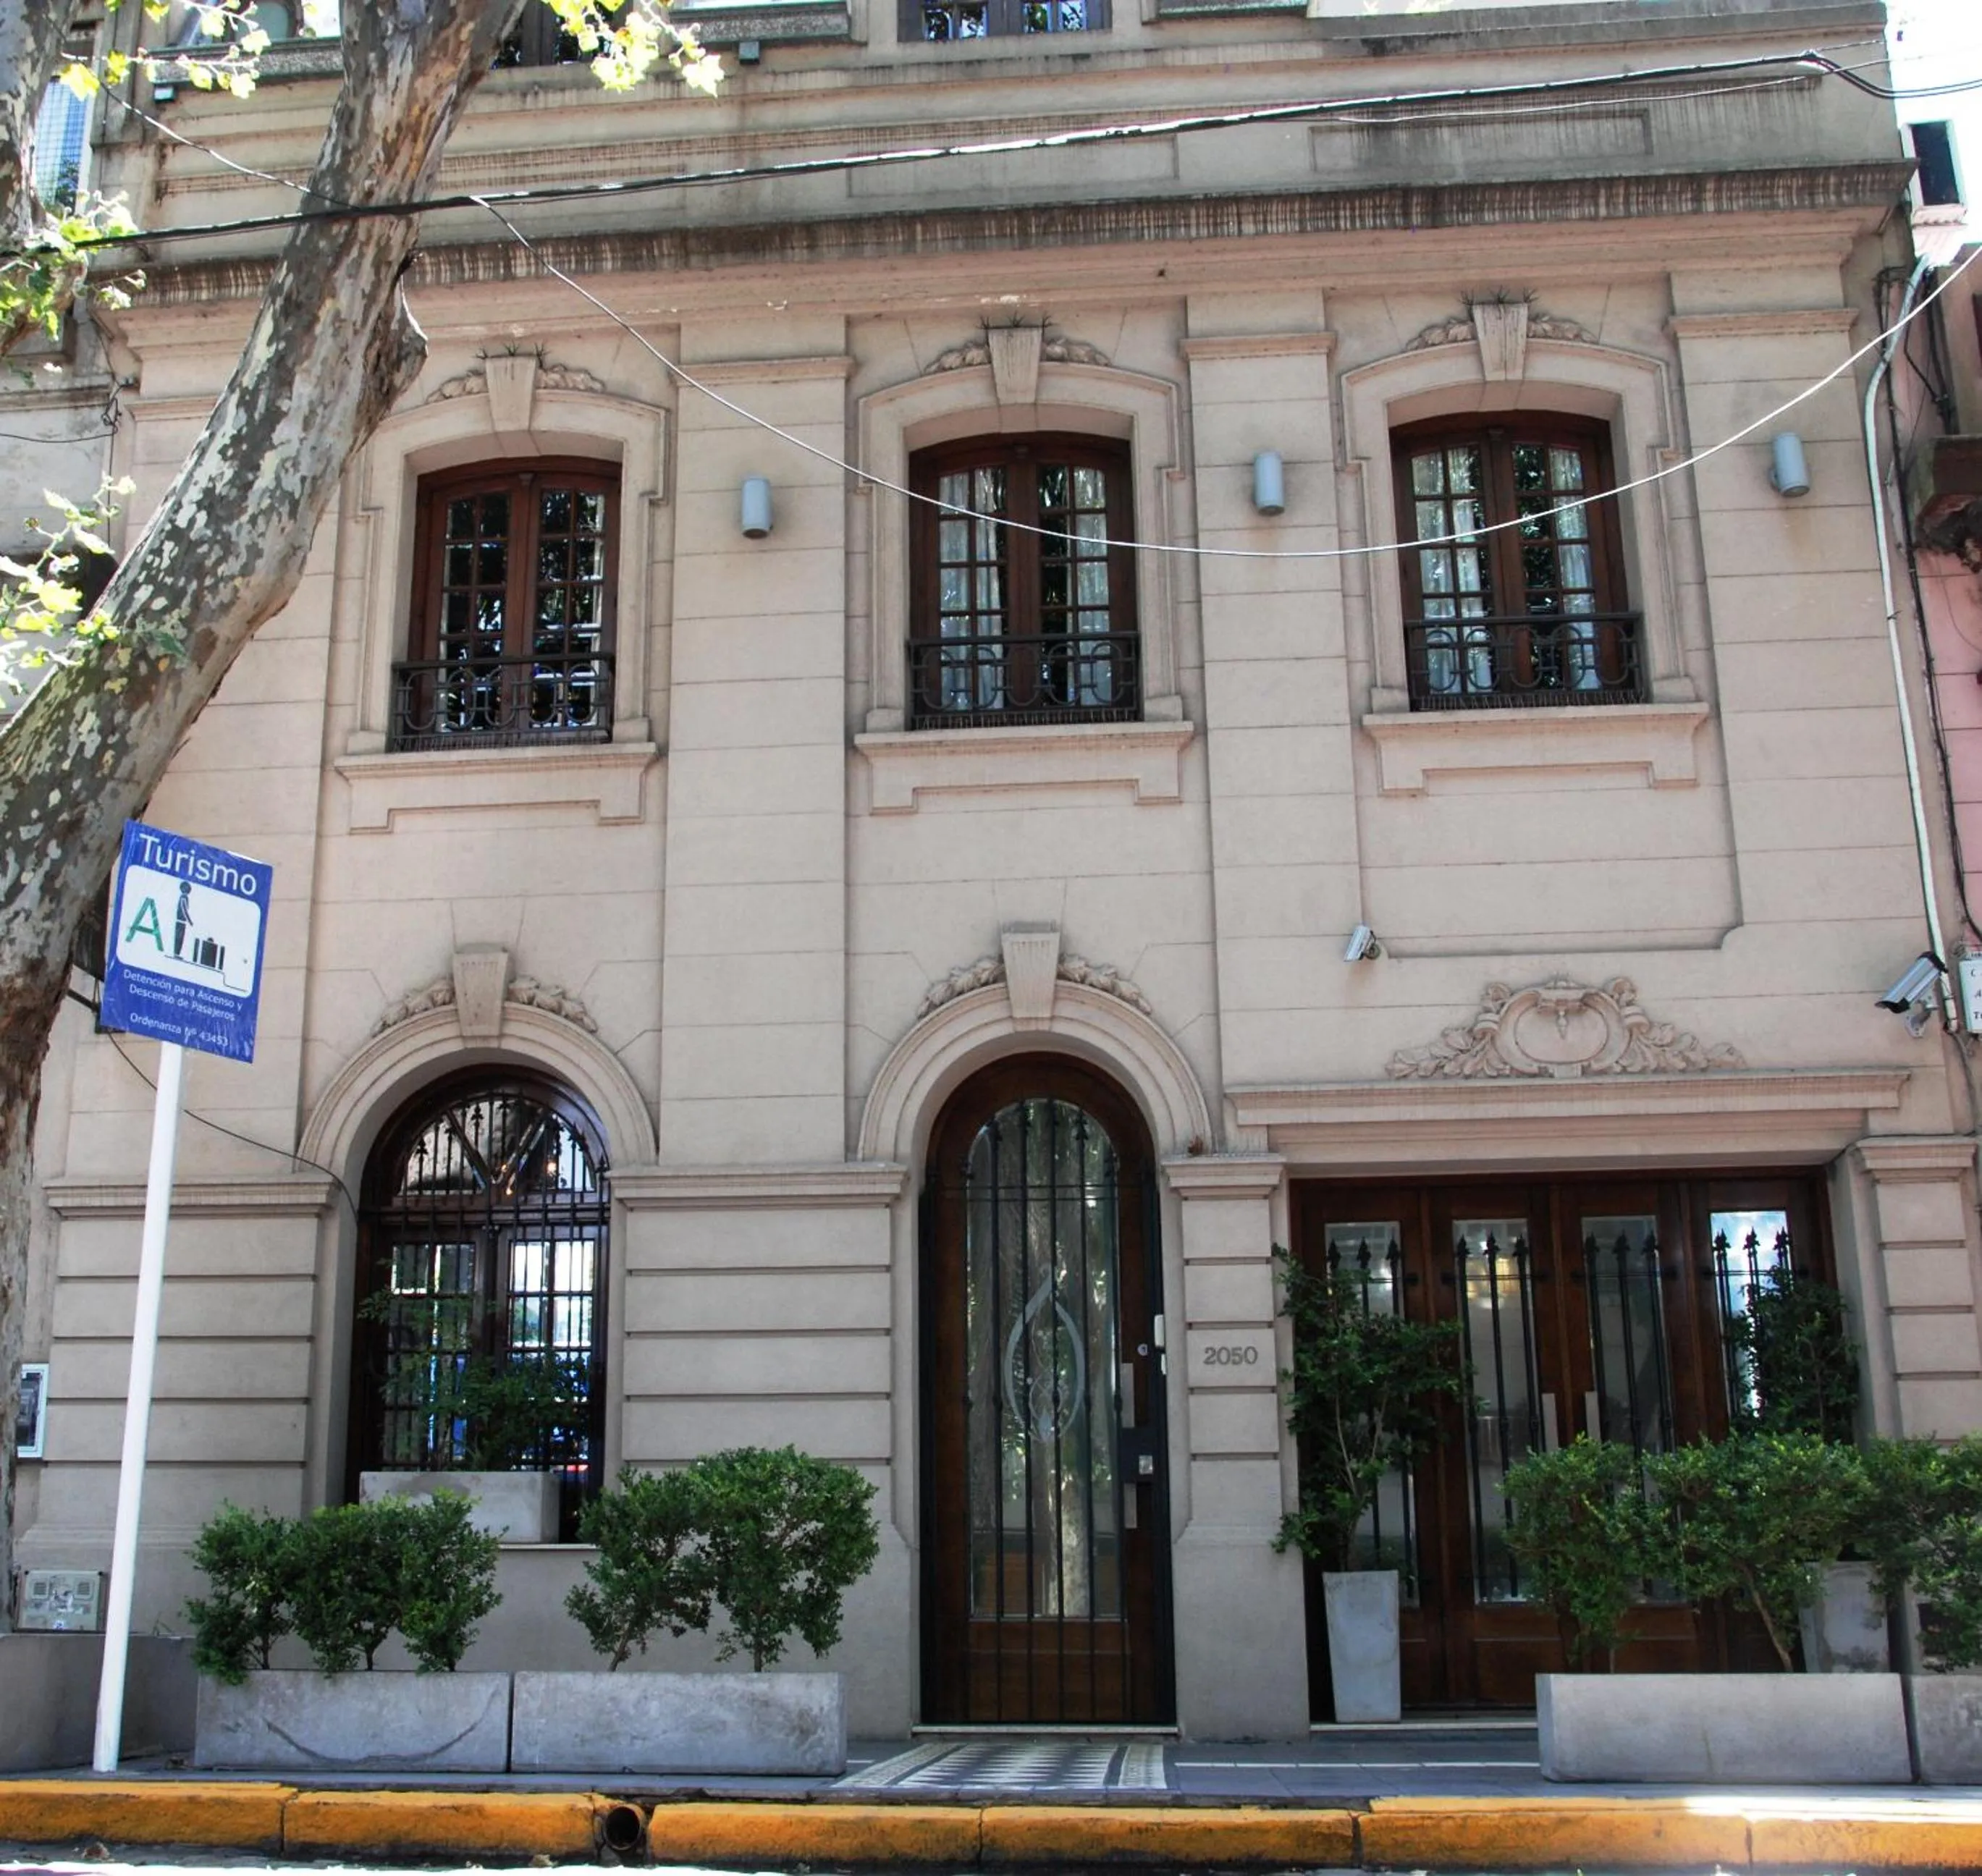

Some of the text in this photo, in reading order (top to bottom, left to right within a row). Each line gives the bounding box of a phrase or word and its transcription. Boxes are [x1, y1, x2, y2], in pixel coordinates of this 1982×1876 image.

[139, 833, 257, 895] Turismo
[125, 897, 164, 952] A
[123, 969, 243, 1012] Detención para Ascenso y
[129, 984, 235, 1021] Descenso de Pasajeros
[130, 1013, 182, 1034] Ordenanza
[1202, 1346, 1258, 1365] 2050
